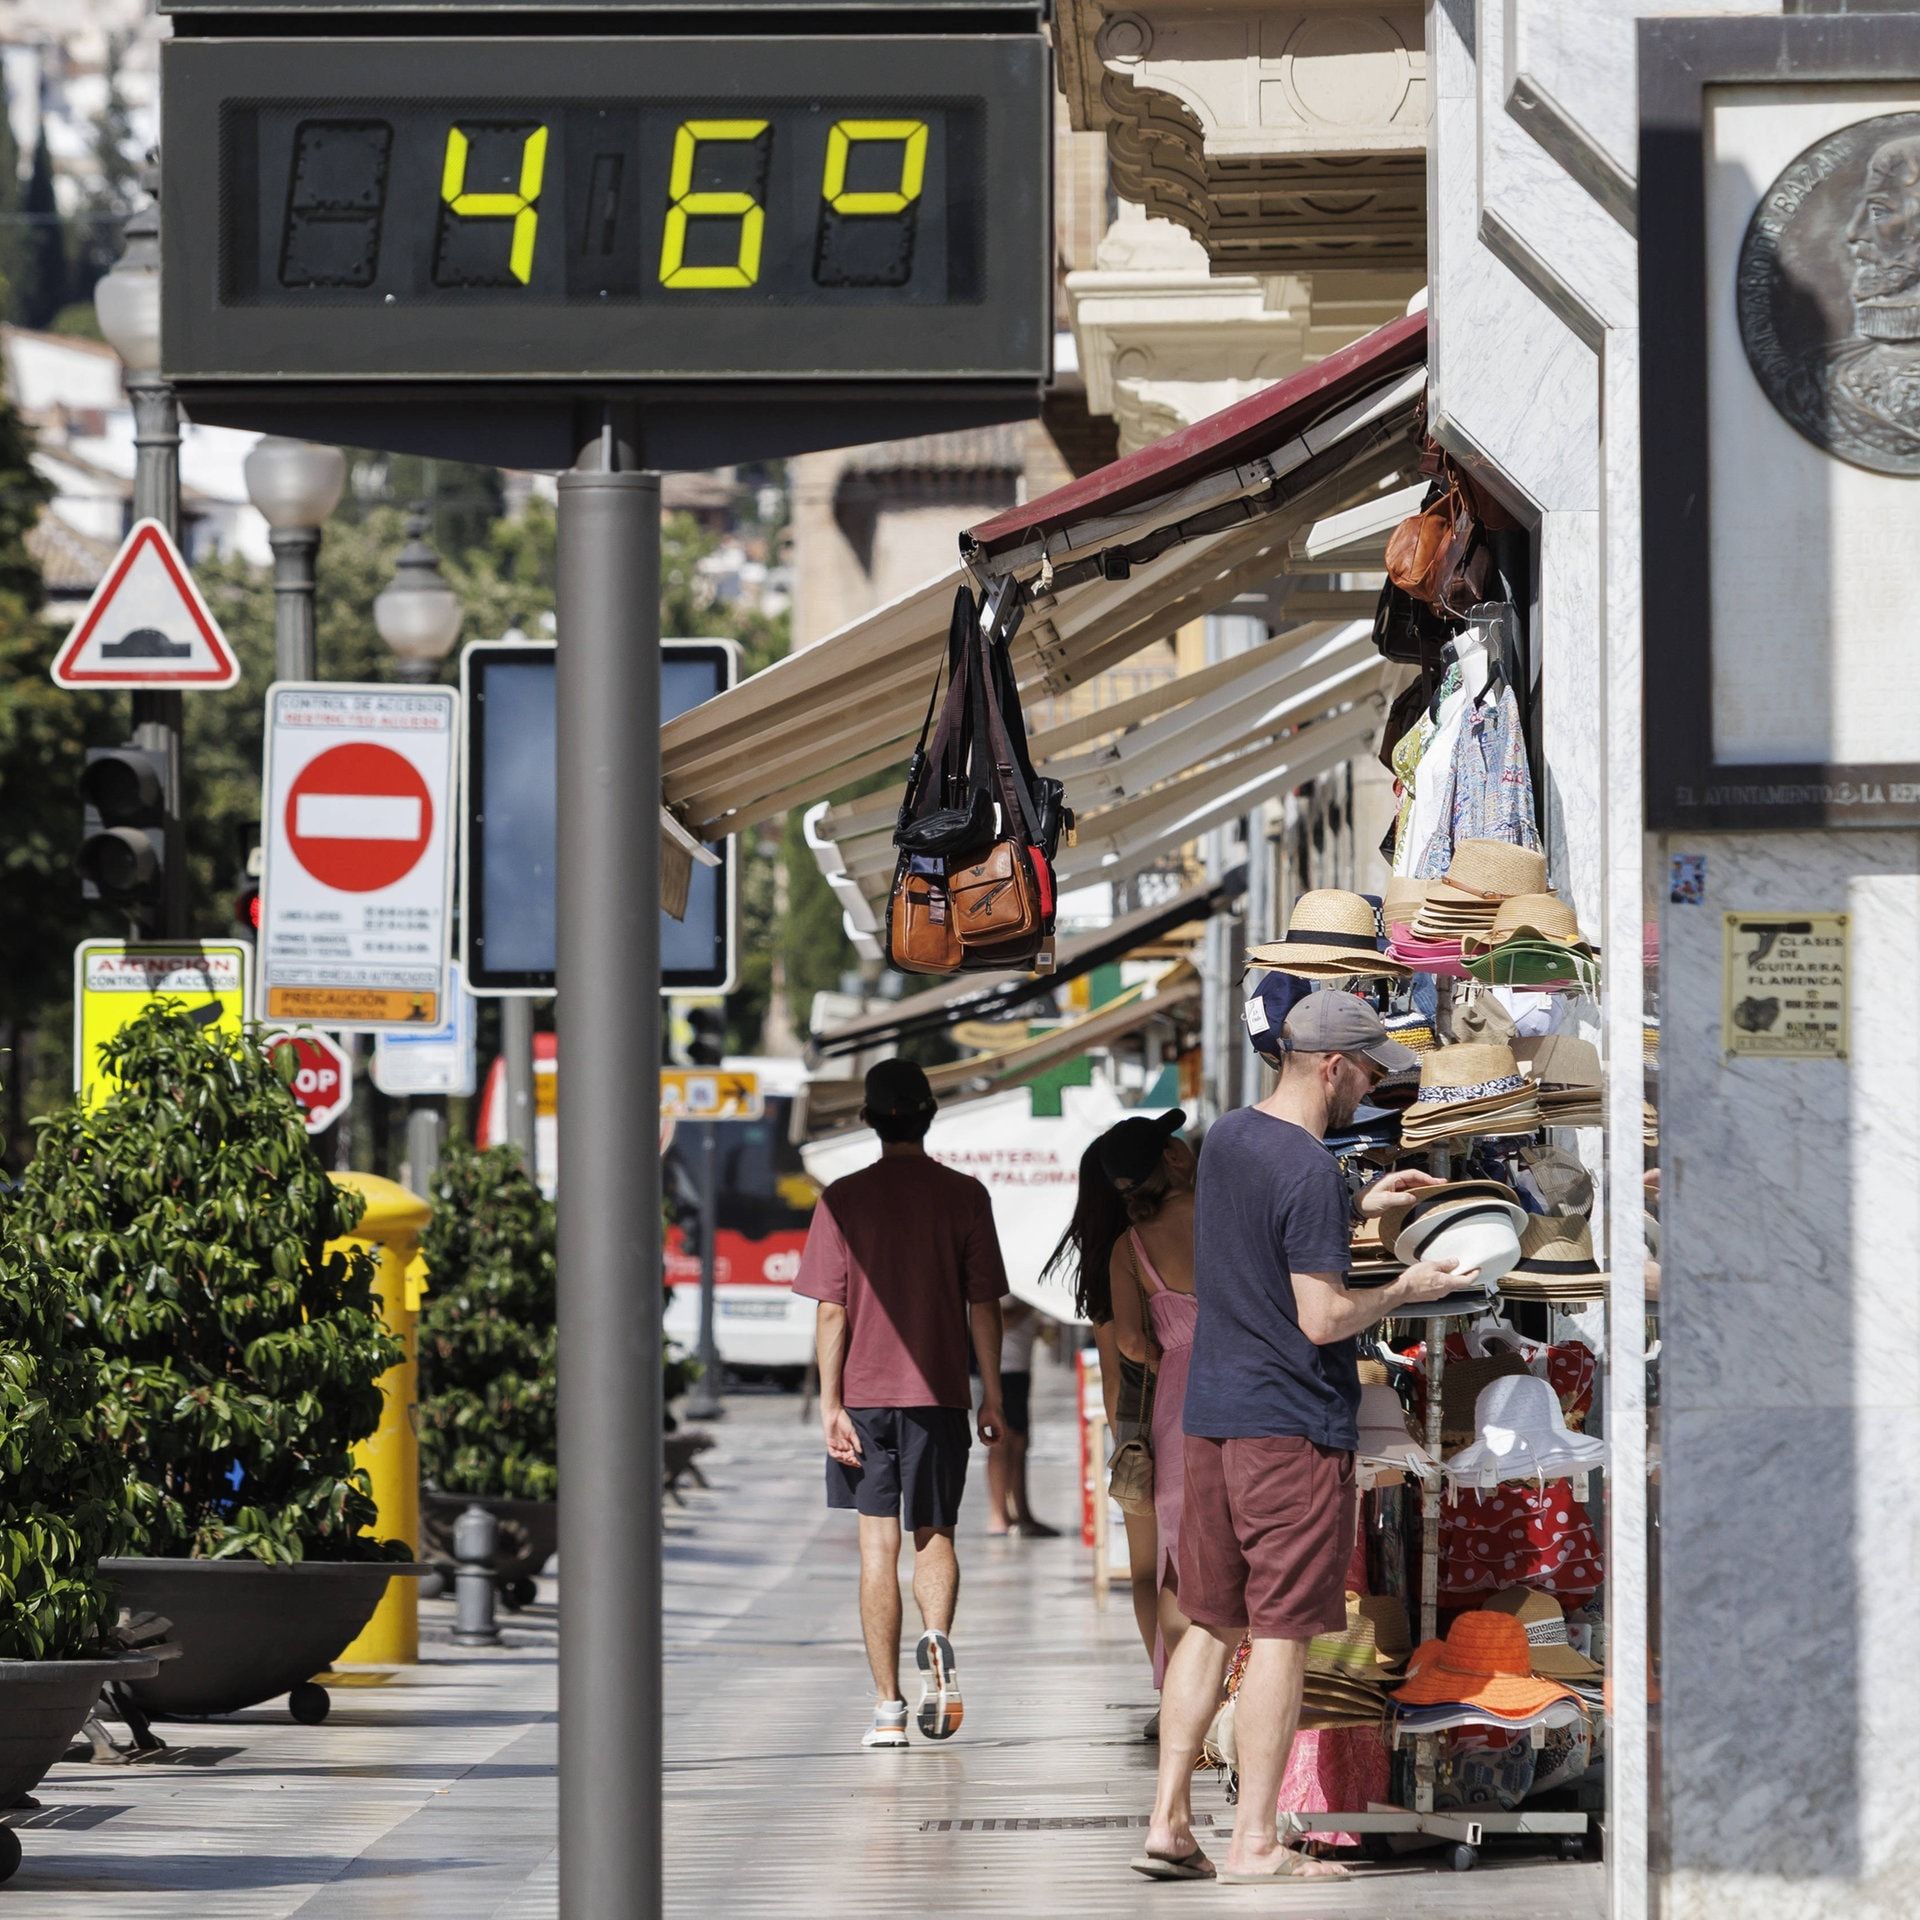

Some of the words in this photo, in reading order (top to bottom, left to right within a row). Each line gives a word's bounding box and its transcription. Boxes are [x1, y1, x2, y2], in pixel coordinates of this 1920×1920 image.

[1779, 937, 1844, 947] CLASES
[1779, 949, 1798, 959] DE
[1756, 963, 1843, 973] GUITARRA
[1748, 977, 1843, 986] FLAMENCA
[295, 1068, 338, 1094] OP
[935, 1150, 1058, 1164] SSANTERIA
